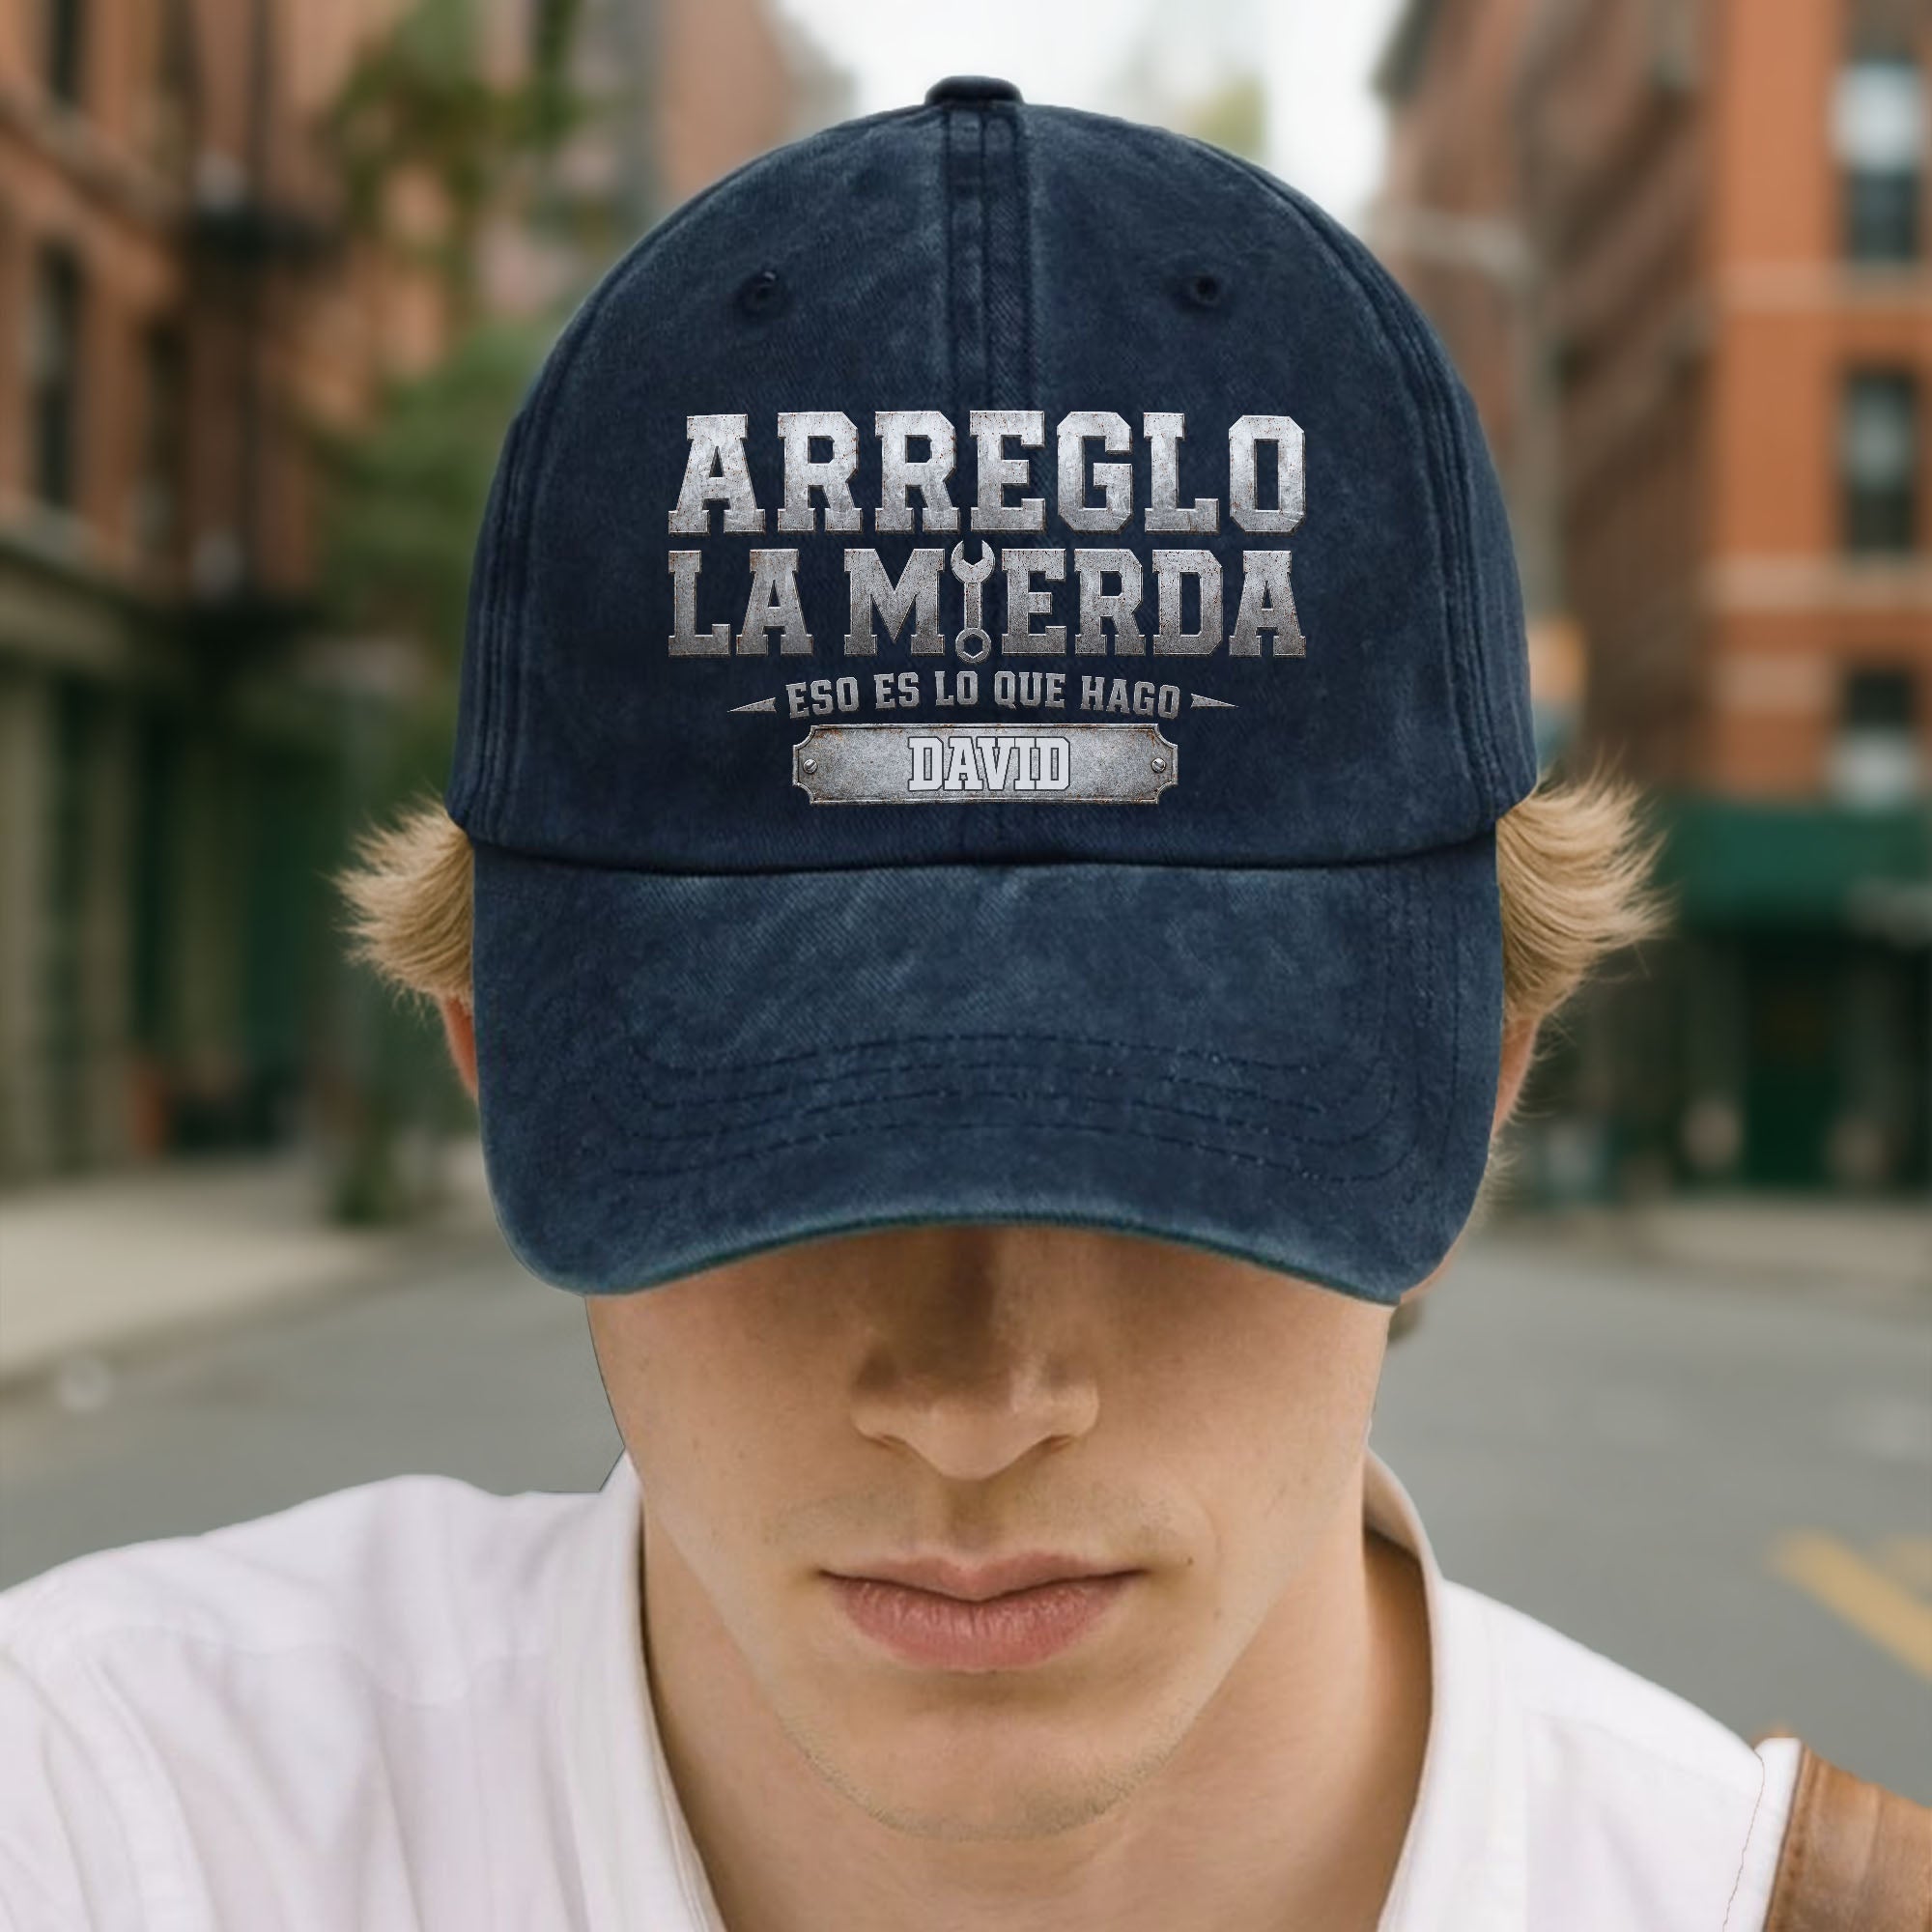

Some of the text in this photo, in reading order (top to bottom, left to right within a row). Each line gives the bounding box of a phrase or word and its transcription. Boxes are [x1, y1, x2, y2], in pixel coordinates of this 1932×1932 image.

[668, 411, 1306, 534] ARREGLO
[668, 549, 813, 656] LA
[785, 670, 1180, 719] ESO ES LO QUE HAGO
[908, 736, 1070, 791] DAVID
